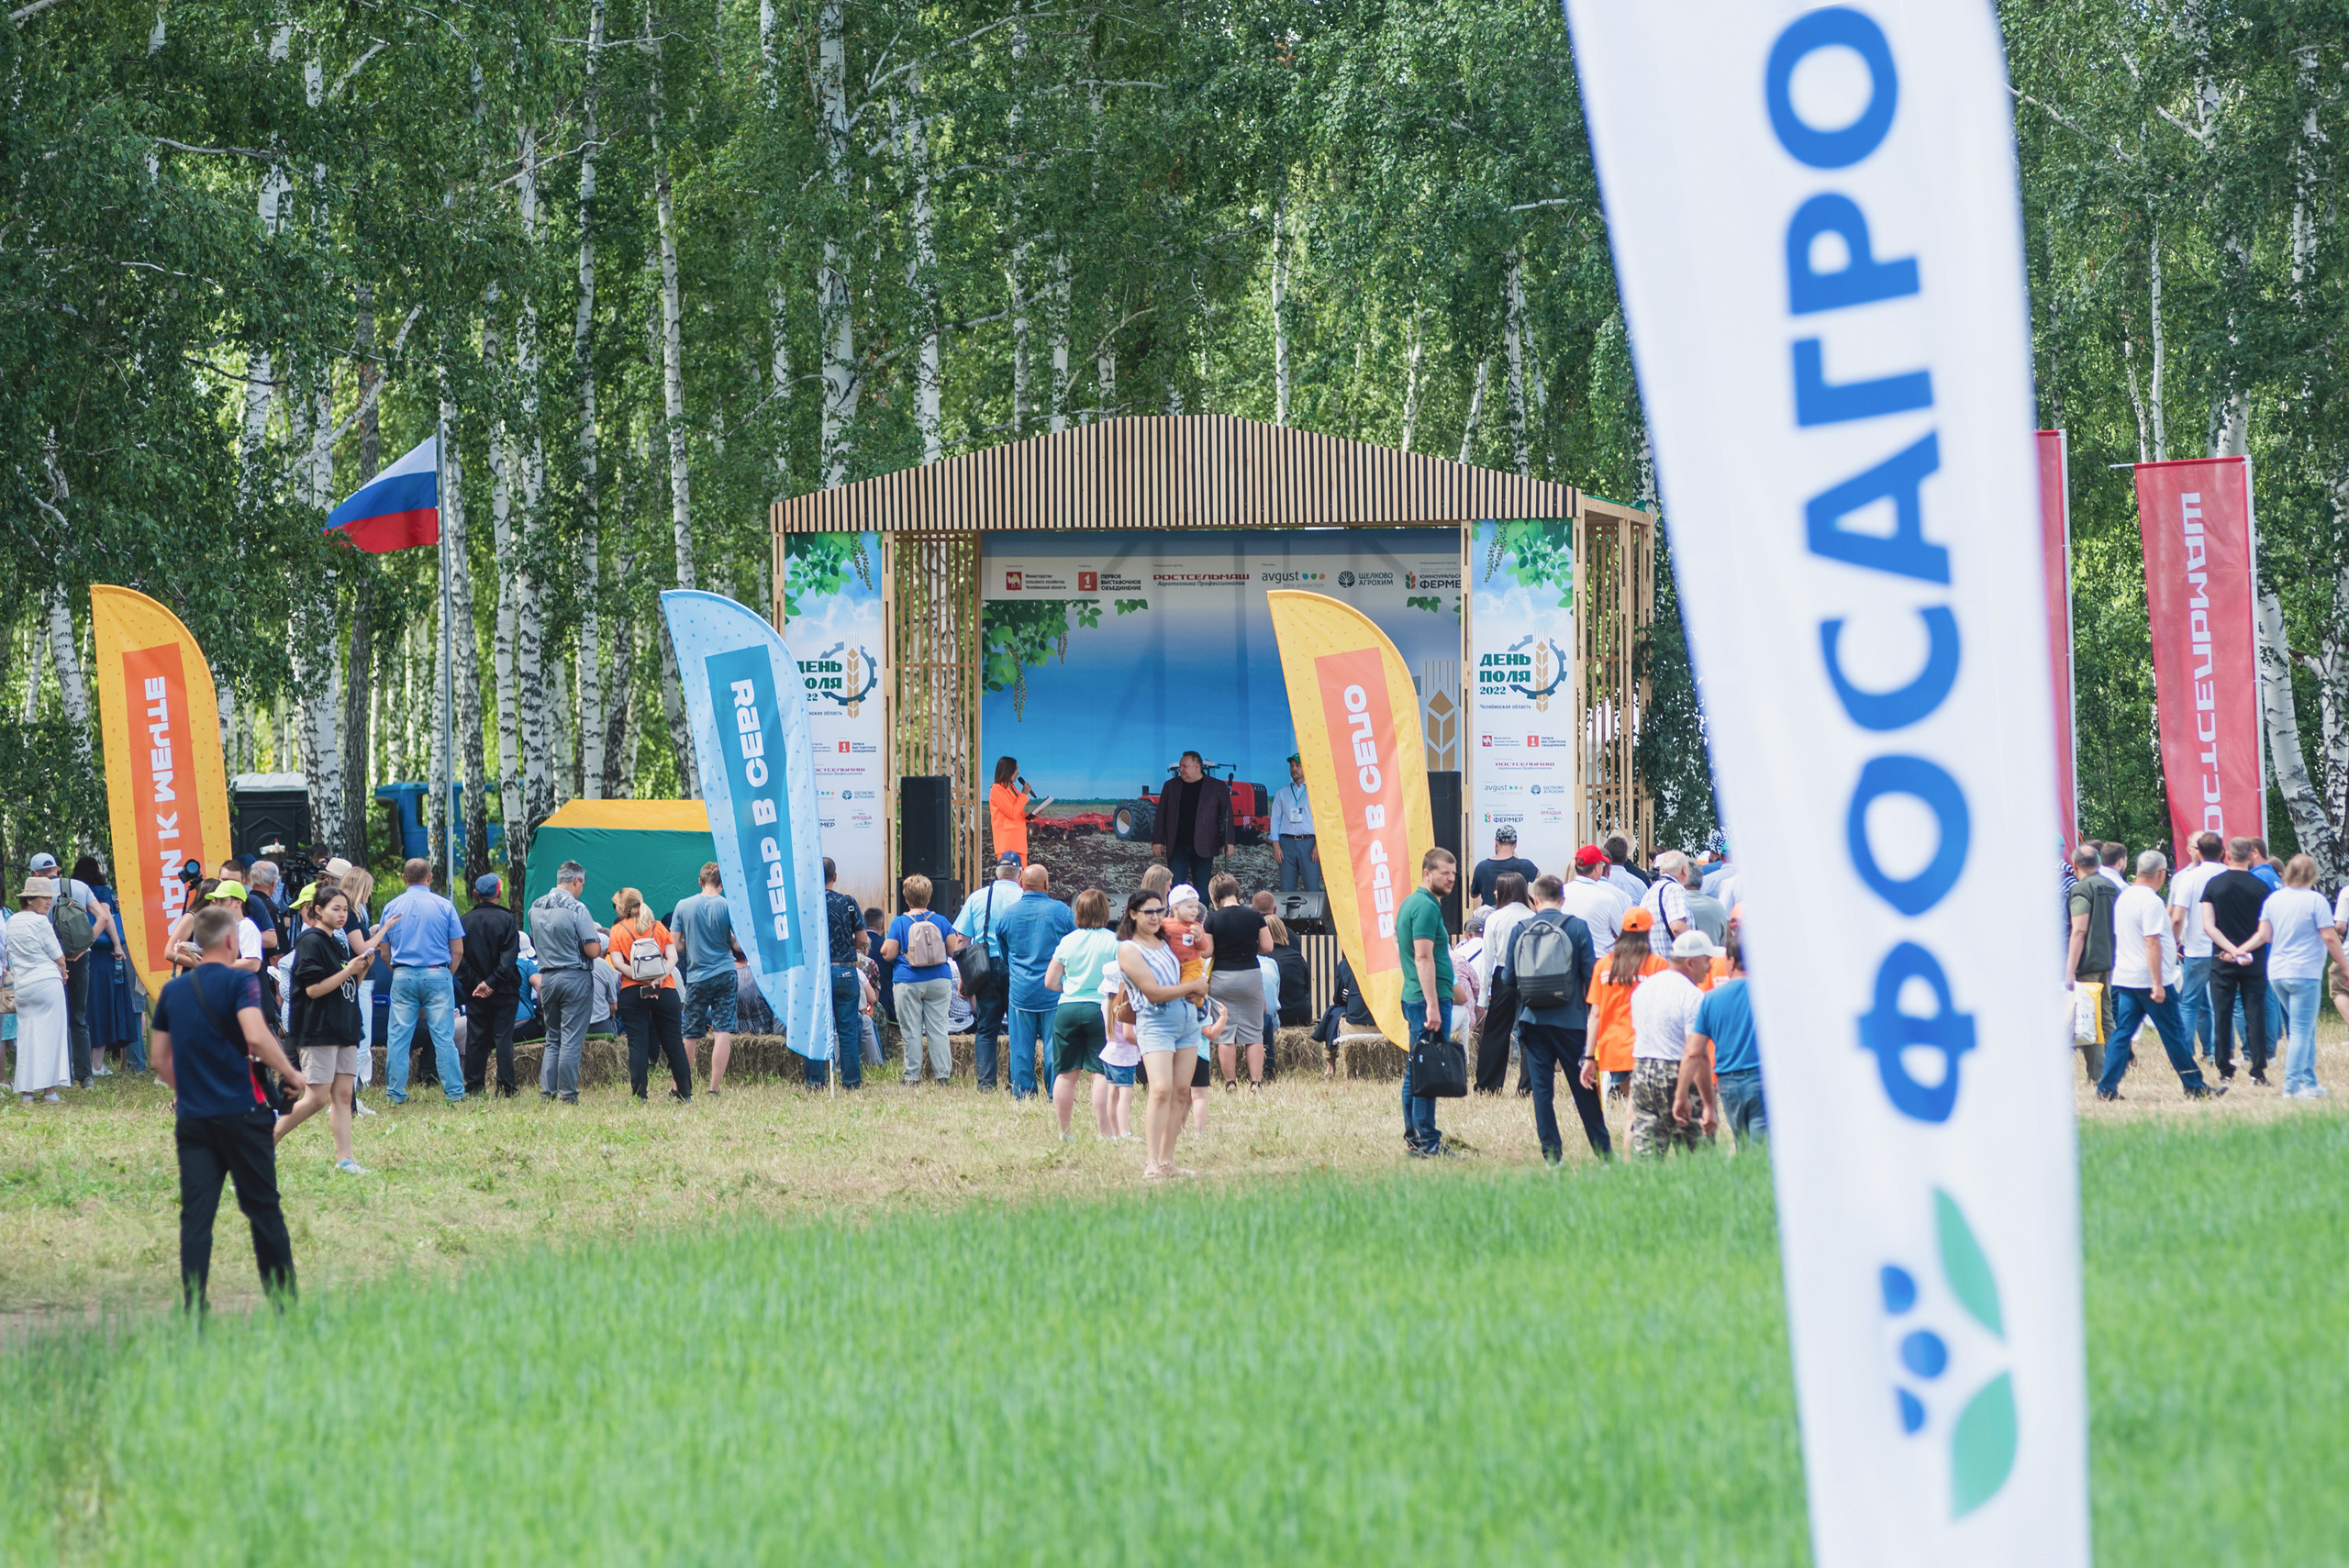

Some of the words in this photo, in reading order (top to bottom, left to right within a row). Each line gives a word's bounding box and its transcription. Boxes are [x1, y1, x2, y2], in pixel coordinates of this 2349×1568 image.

[1763, 5, 1978, 1125] ФОСАГРО
[1261, 571, 1299, 584] avgust
[1419, 580, 1462, 589] ФЕРМЕ
[1479, 653, 1531, 667] ДЕНЬ
[1479, 670, 1531, 683] ПОЛЯ
[803, 677, 842, 690] ОЛЯ
[806, 693, 818, 701] 22
[1479, 686, 1507, 695] 2022
[1485, 784, 1508, 793] avgust
